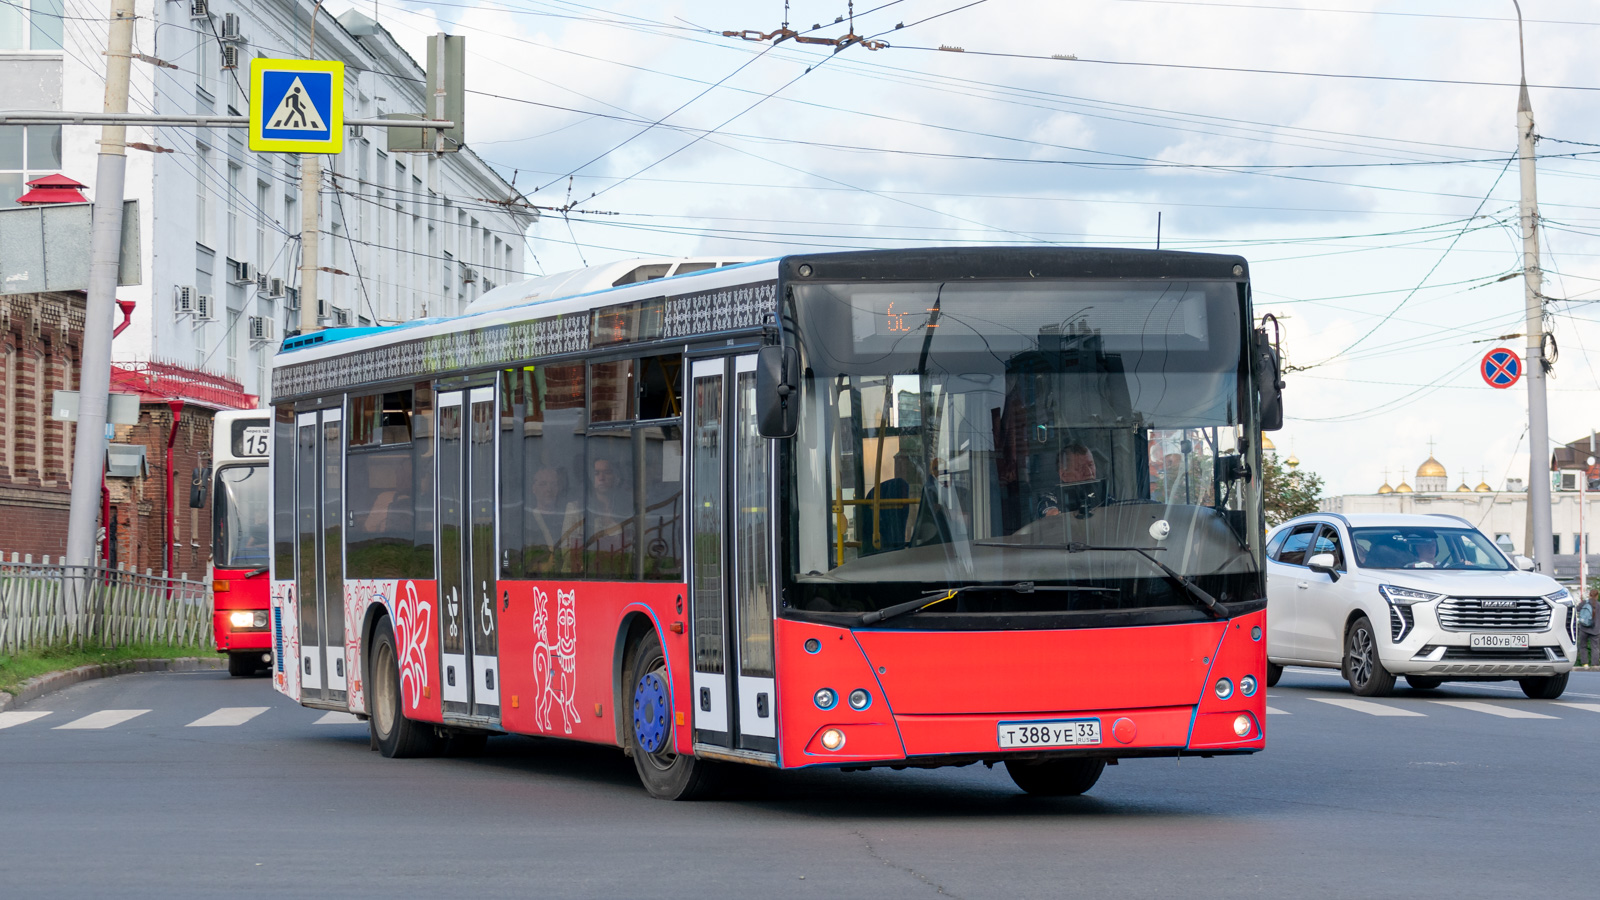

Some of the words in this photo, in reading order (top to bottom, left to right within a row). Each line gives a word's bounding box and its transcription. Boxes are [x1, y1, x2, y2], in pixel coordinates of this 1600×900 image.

[246, 435, 269, 454] 15
[1512, 635, 1526, 644] 790
[1007, 727, 1073, 744] Т388УЕ
[1078, 724, 1094, 736] 33
